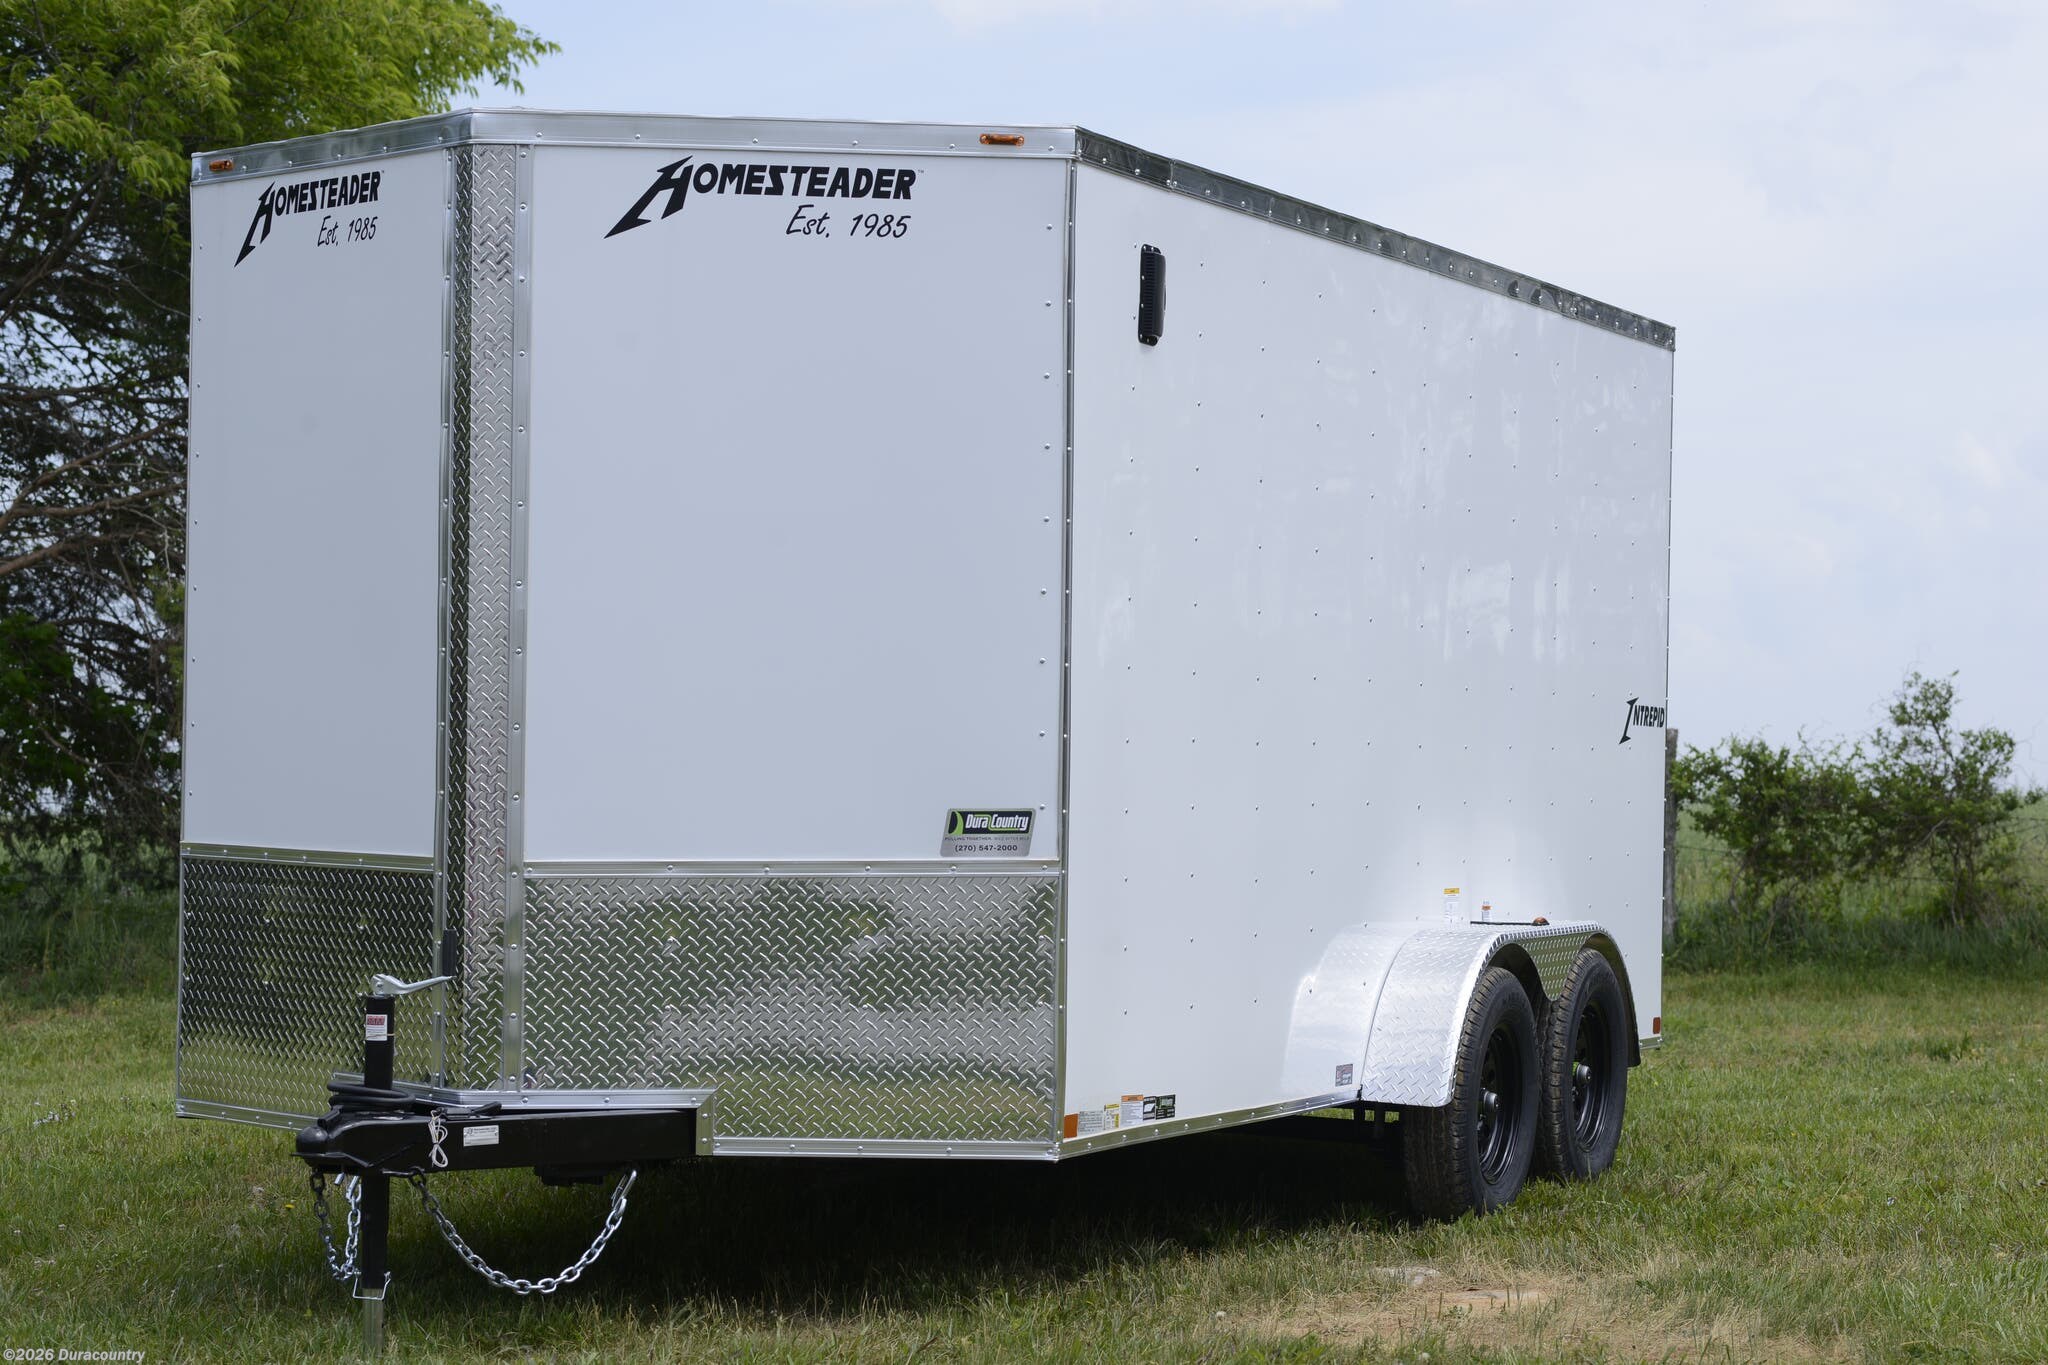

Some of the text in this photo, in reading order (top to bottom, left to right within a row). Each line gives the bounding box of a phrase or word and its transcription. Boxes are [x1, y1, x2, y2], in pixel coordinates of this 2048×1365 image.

[603, 155, 917, 239] HOMESTEADER
[234, 170, 381, 268] HOMESTEADER
[347, 215, 379, 243] 1985
[849, 213, 911, 238] 1985
[1618, 696, 1665, 745] INTREPID
[965, 813, 1029, 831] Dura Country
[954, 844, 976, 852] (270)
